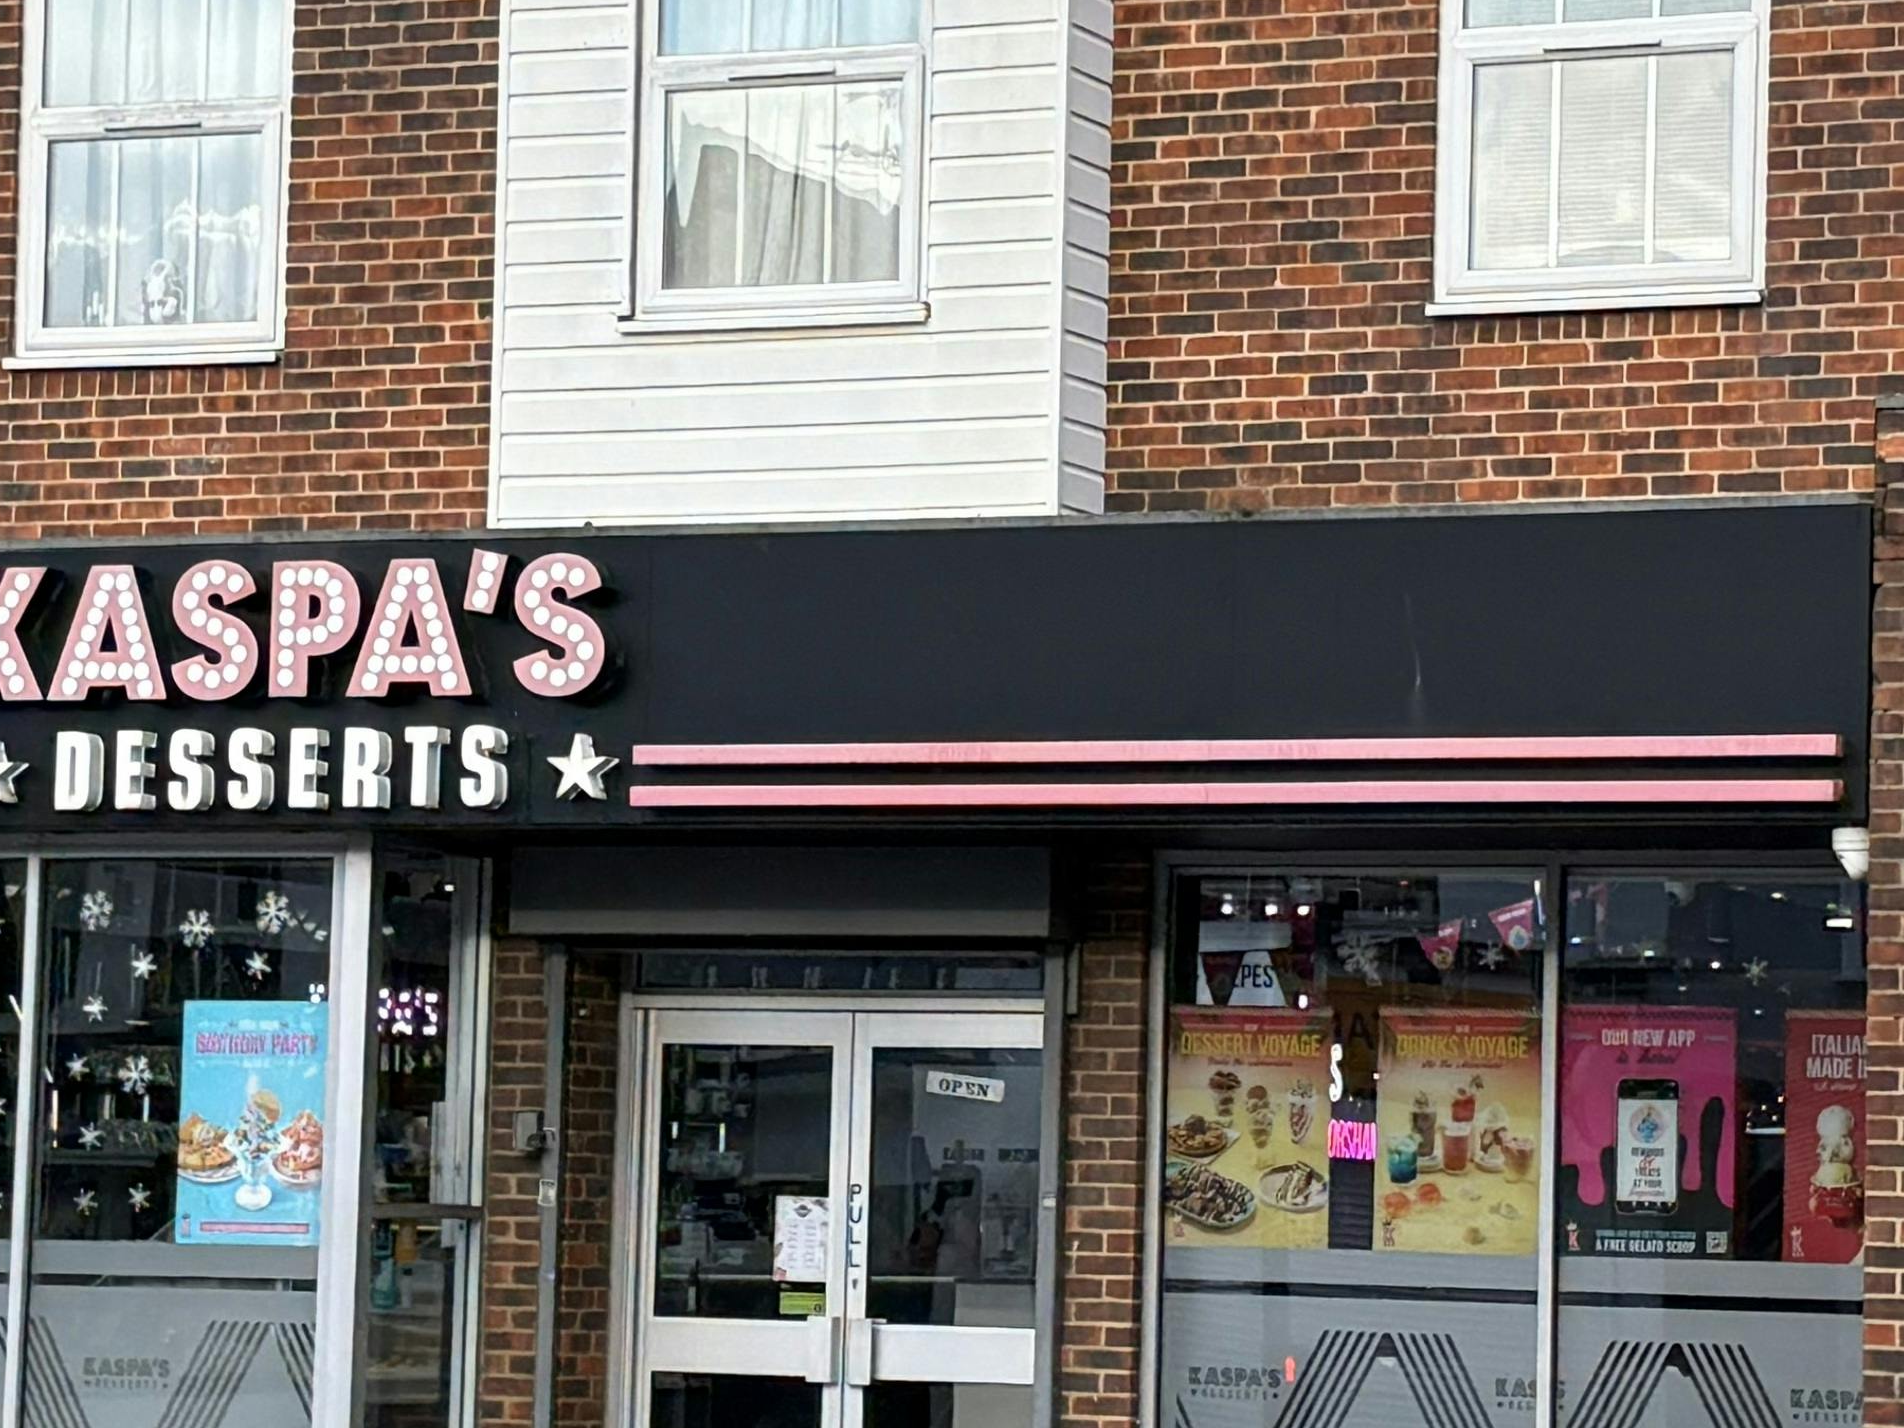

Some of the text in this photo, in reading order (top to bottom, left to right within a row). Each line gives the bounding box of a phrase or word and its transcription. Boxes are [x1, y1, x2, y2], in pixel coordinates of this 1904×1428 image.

[54, 724, 509, 811] DESSERTS
[1182, 1031, 1322, 1057] DESSERT VOYAGE
[1396, 1035, 1529, 1058] DRINKS VOYAGE
[1633, 1030, 1664, 1047] NEW
[1668, 1031, 1695, 1047] APP
[1807, 1057, 1853, 1079] MADE
[939, 1078, 990, 1097] OPEN
[848, 1183, 863, 1269] PULL
[83, 1357, 170, 1377] KASPA'S
[1189, 1366, 1281, 1388] KASPA'S
